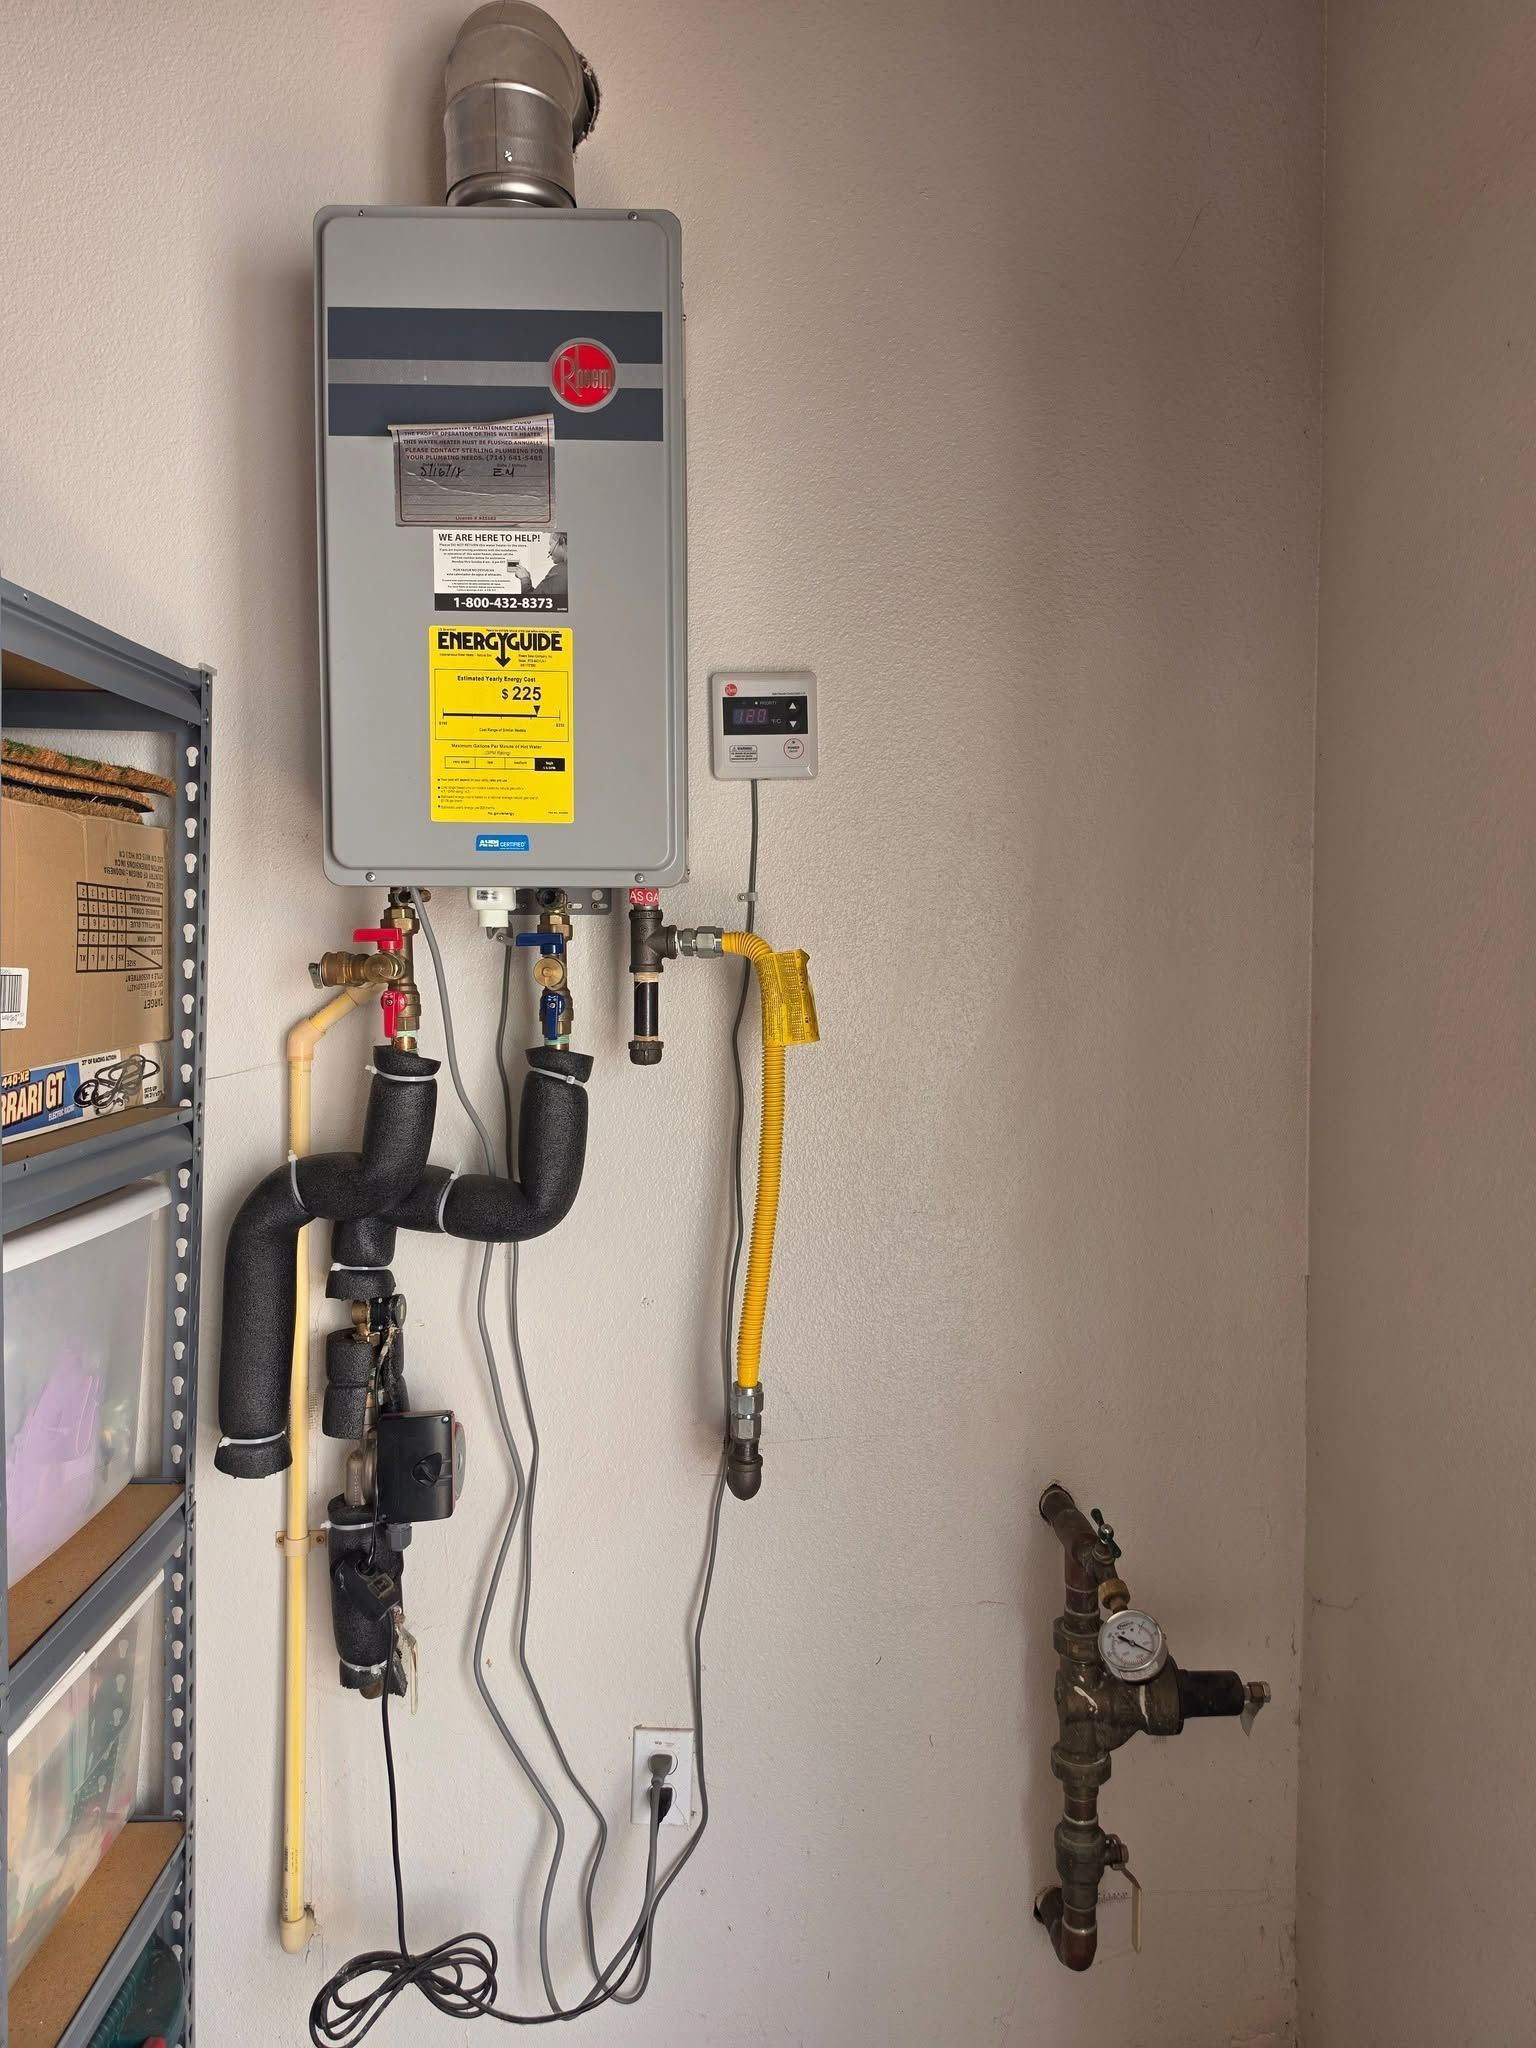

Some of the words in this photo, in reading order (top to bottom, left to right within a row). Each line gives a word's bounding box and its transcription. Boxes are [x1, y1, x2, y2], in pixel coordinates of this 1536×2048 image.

[559, 345, 613, 398] Rheem
[438, 533, 453, 541] WE
[454, 533, 473, 541] ARE
[475, 533, 498, 541] HERE
[500, 533, 512, 541] TO
[514, 534, 541, 542] HELP!
[453, 597, 553, 609] 1-800-432-8373
[437, 631, 562, 652] ENERGYGUIDE
[501, 688, 509, 700] $
[512, 686, 542, 701] 225
[143, 999, 164, 1010] TARGET
[46, 1070, 66, 1110] GT
